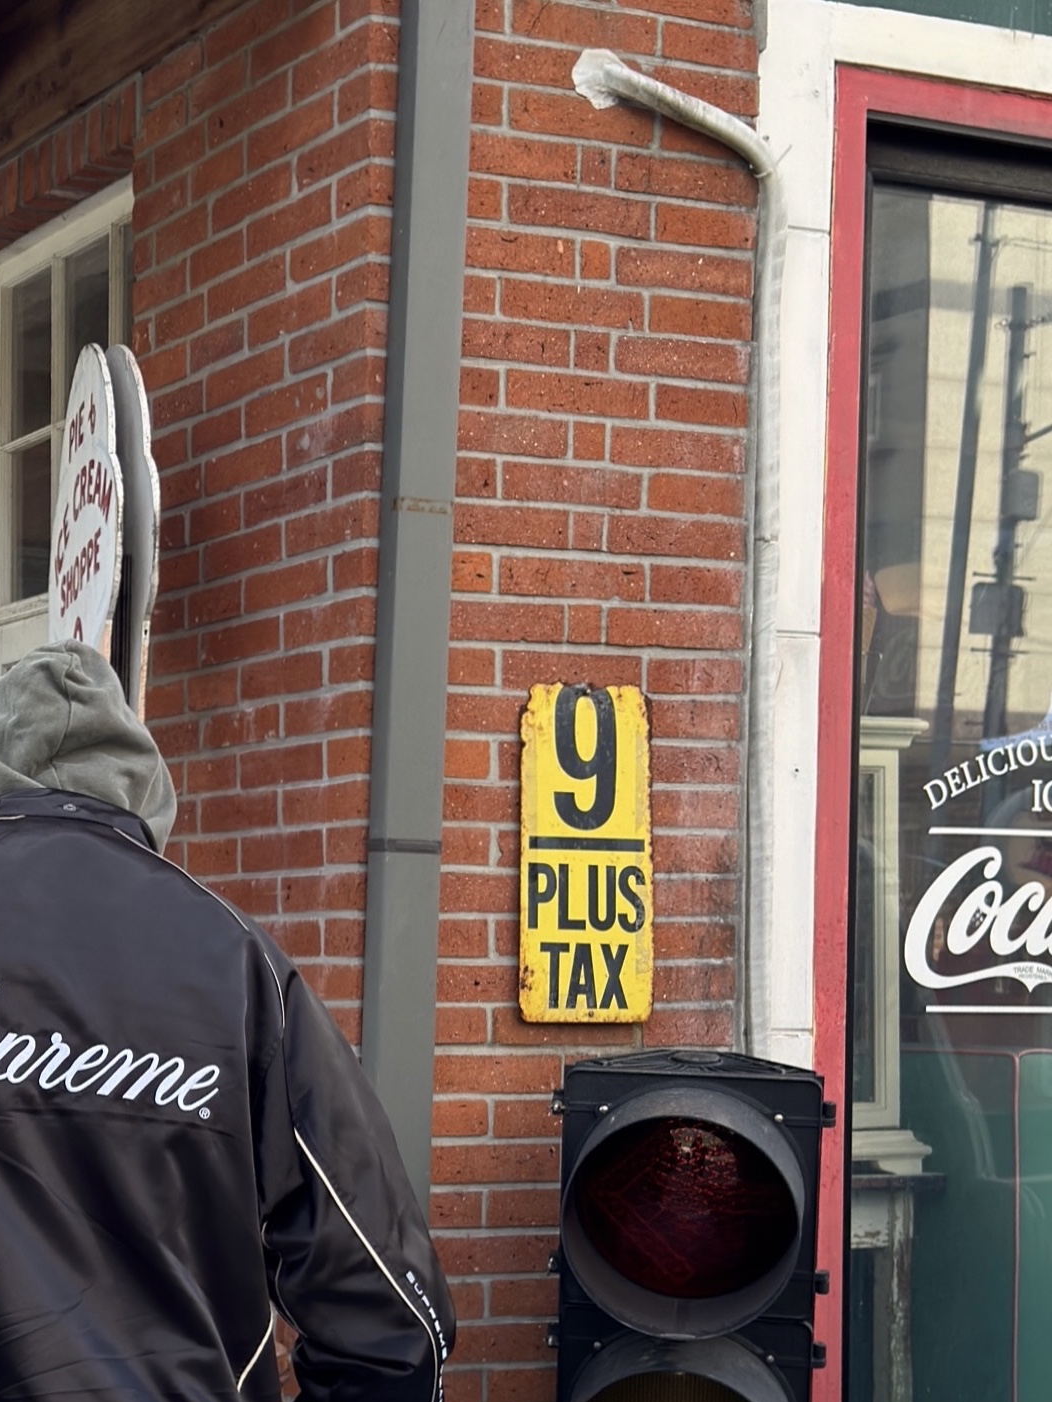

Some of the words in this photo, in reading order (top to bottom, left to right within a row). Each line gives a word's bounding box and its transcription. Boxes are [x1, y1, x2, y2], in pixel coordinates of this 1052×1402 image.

[68, 401, 85, 464] PIE
[54, 503, 70, 588] ICE
[72, 458, 113, 524] CREAM
[60, 527, 102, 618] SHOPPE
[553, 686, 617, 831] 9
[527, 862, 646, 934] PLUS
[540, 942, 629, 1010] TAX
